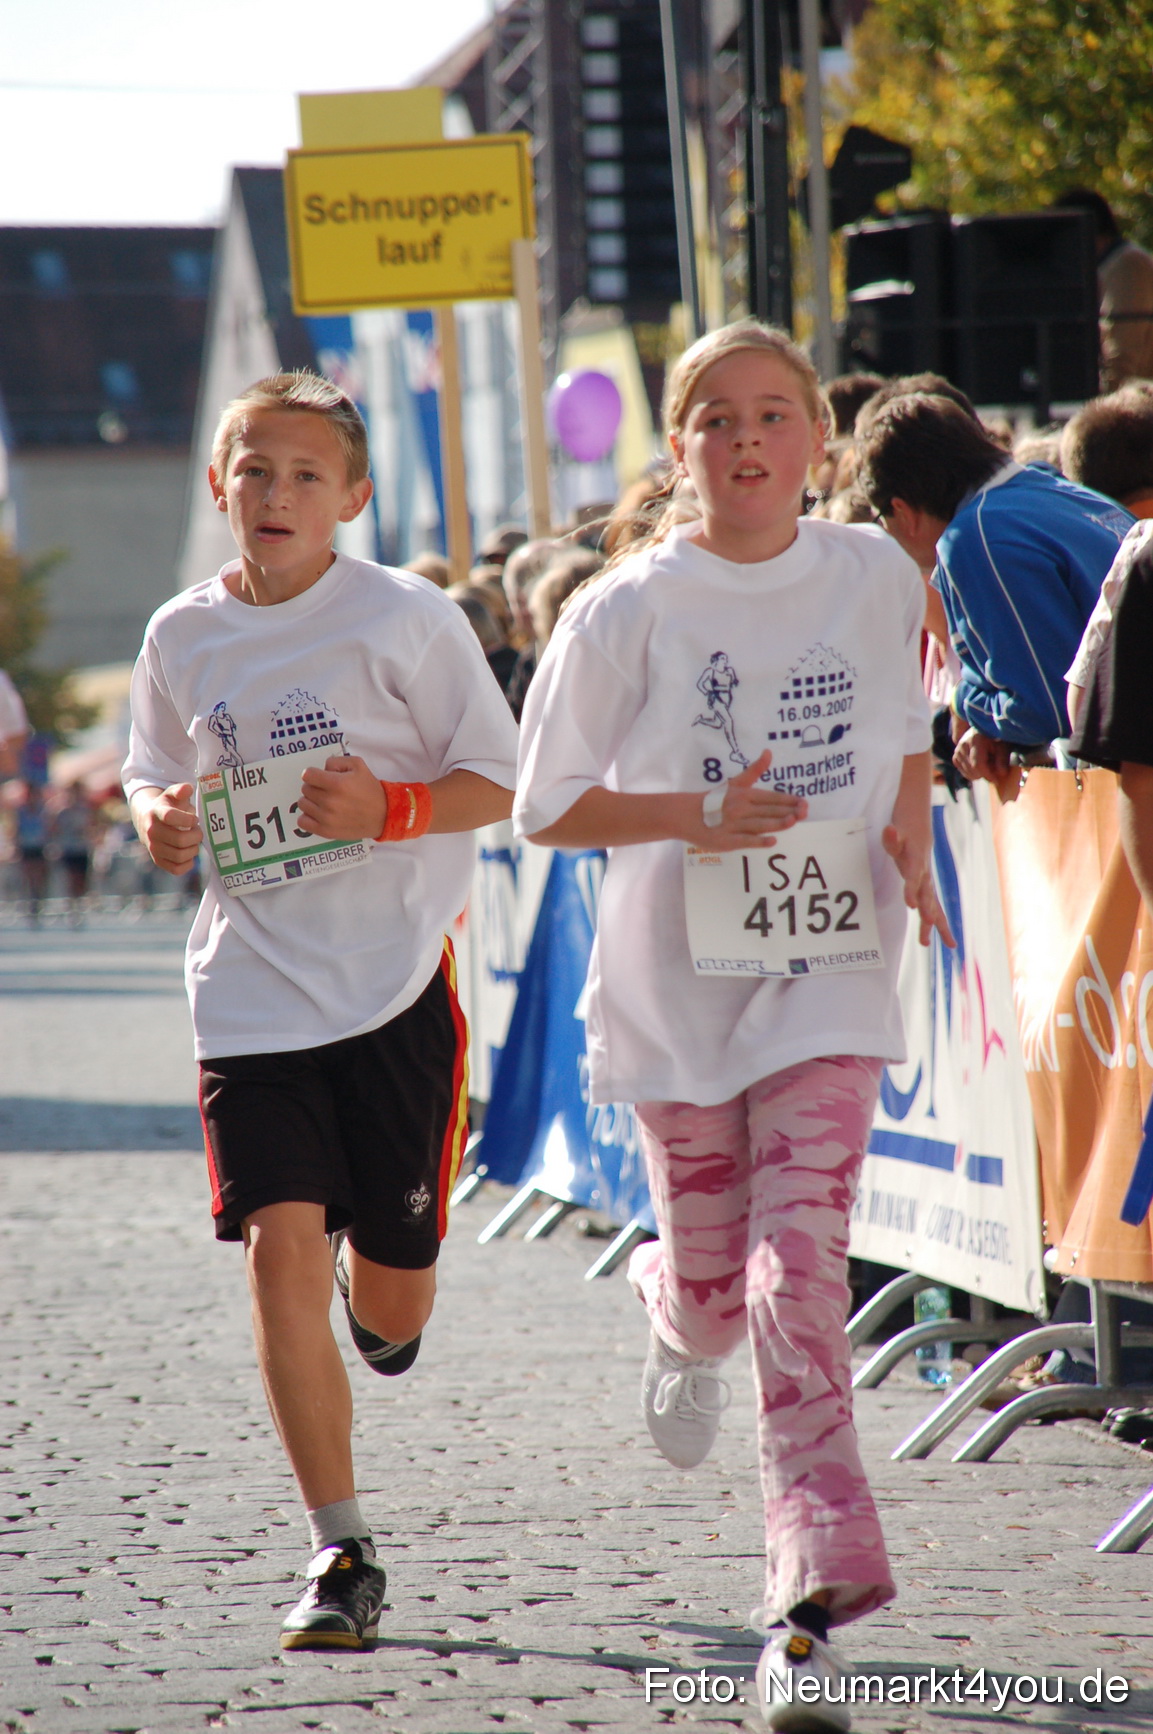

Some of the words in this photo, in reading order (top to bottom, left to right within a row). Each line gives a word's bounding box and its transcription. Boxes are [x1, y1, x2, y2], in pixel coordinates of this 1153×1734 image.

[304, 189, 509, 226] Schnupper-
[377, 230, 443, 266] lauf
[777, 696, 854, 722] 16.09.2007
[269, 732, 345, 758] 16.09.2007
[232, 766, 268, 791] Alex
[743, 751, 854, 782] eumarkter
[773, 767, 856, 798] Stadtlauf
[209, 813, 226, 832] Sc
[301, 843, 366, 869] PFLEIDERER
[223, 867, 267, 889] BOCK
[741, 853, 828, 893] ISA
[743, 890, 860, 938] 4152
[696, 958, 765, 973] BOCK
[809, 949, 880, 968] PFLEIDERER
